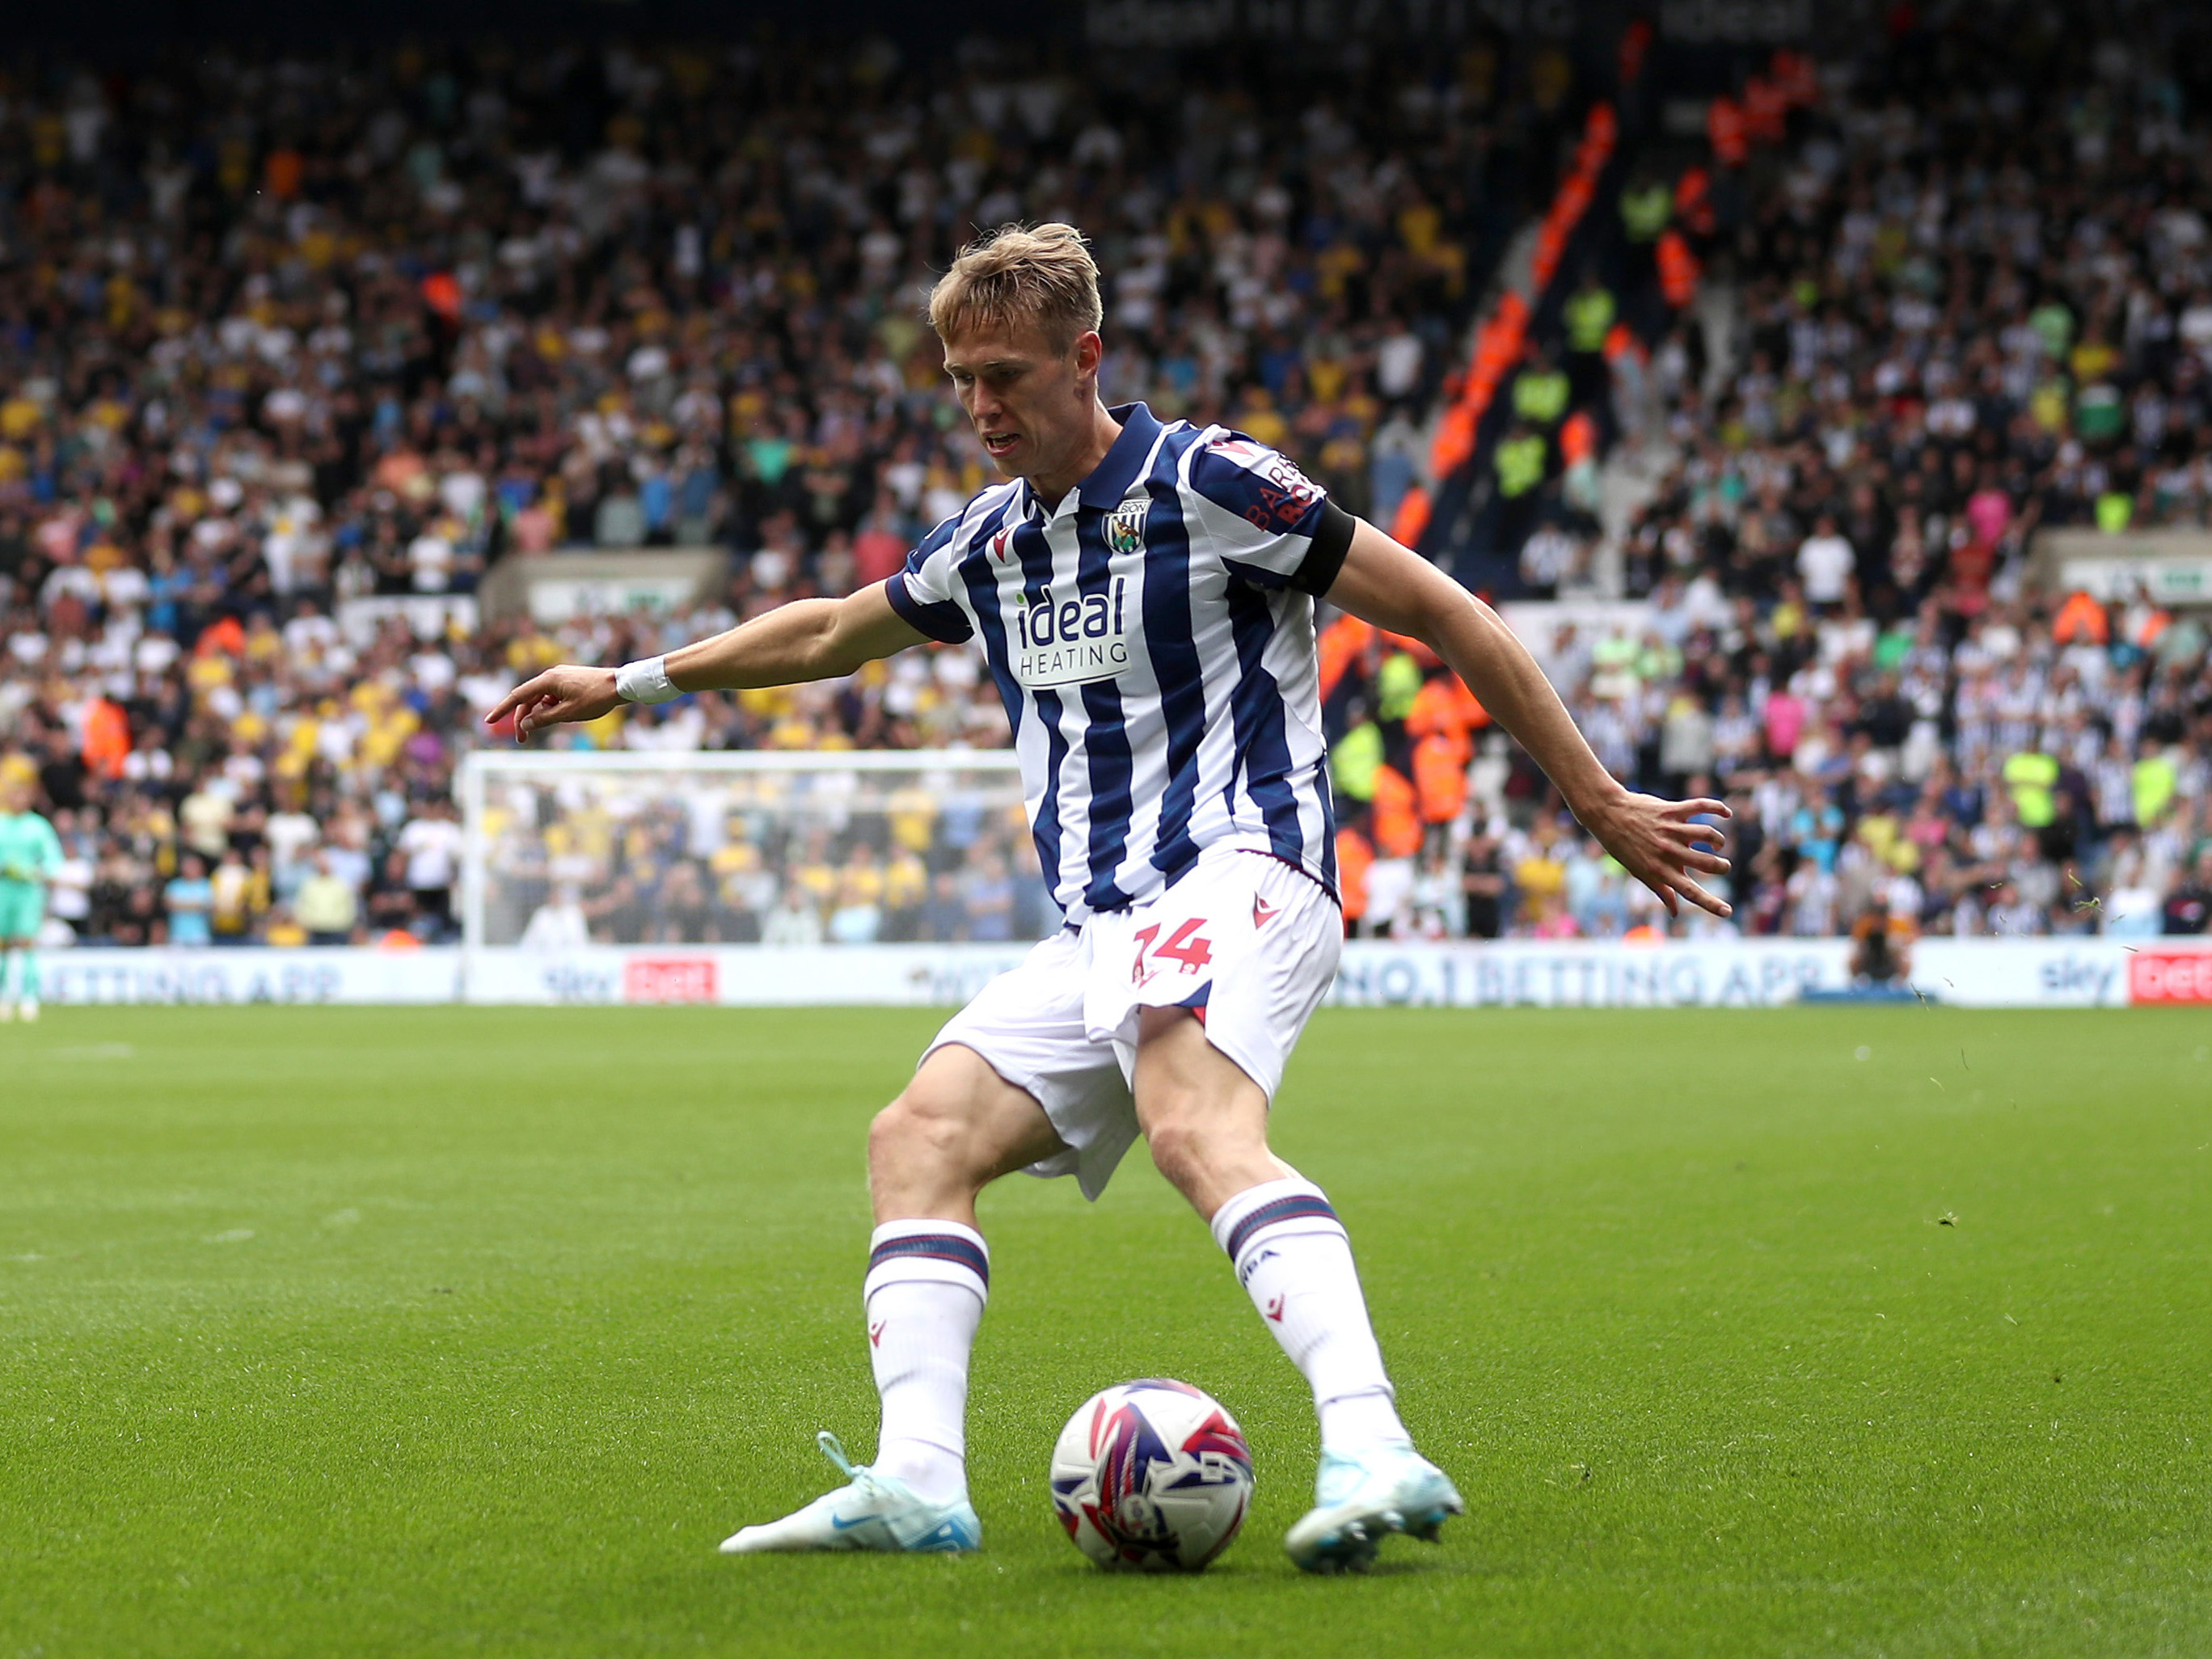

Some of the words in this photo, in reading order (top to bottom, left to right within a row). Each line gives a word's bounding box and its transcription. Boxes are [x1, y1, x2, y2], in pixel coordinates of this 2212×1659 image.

[1016, 577, 1125, 649] ideal
[1020, 643, 1127, 677] HEATING
[1475, 957, 1703, 1005] BETTING
[1720, 956, 1825, 1004] APP
[2038, 952, 2121, 1007] sky
